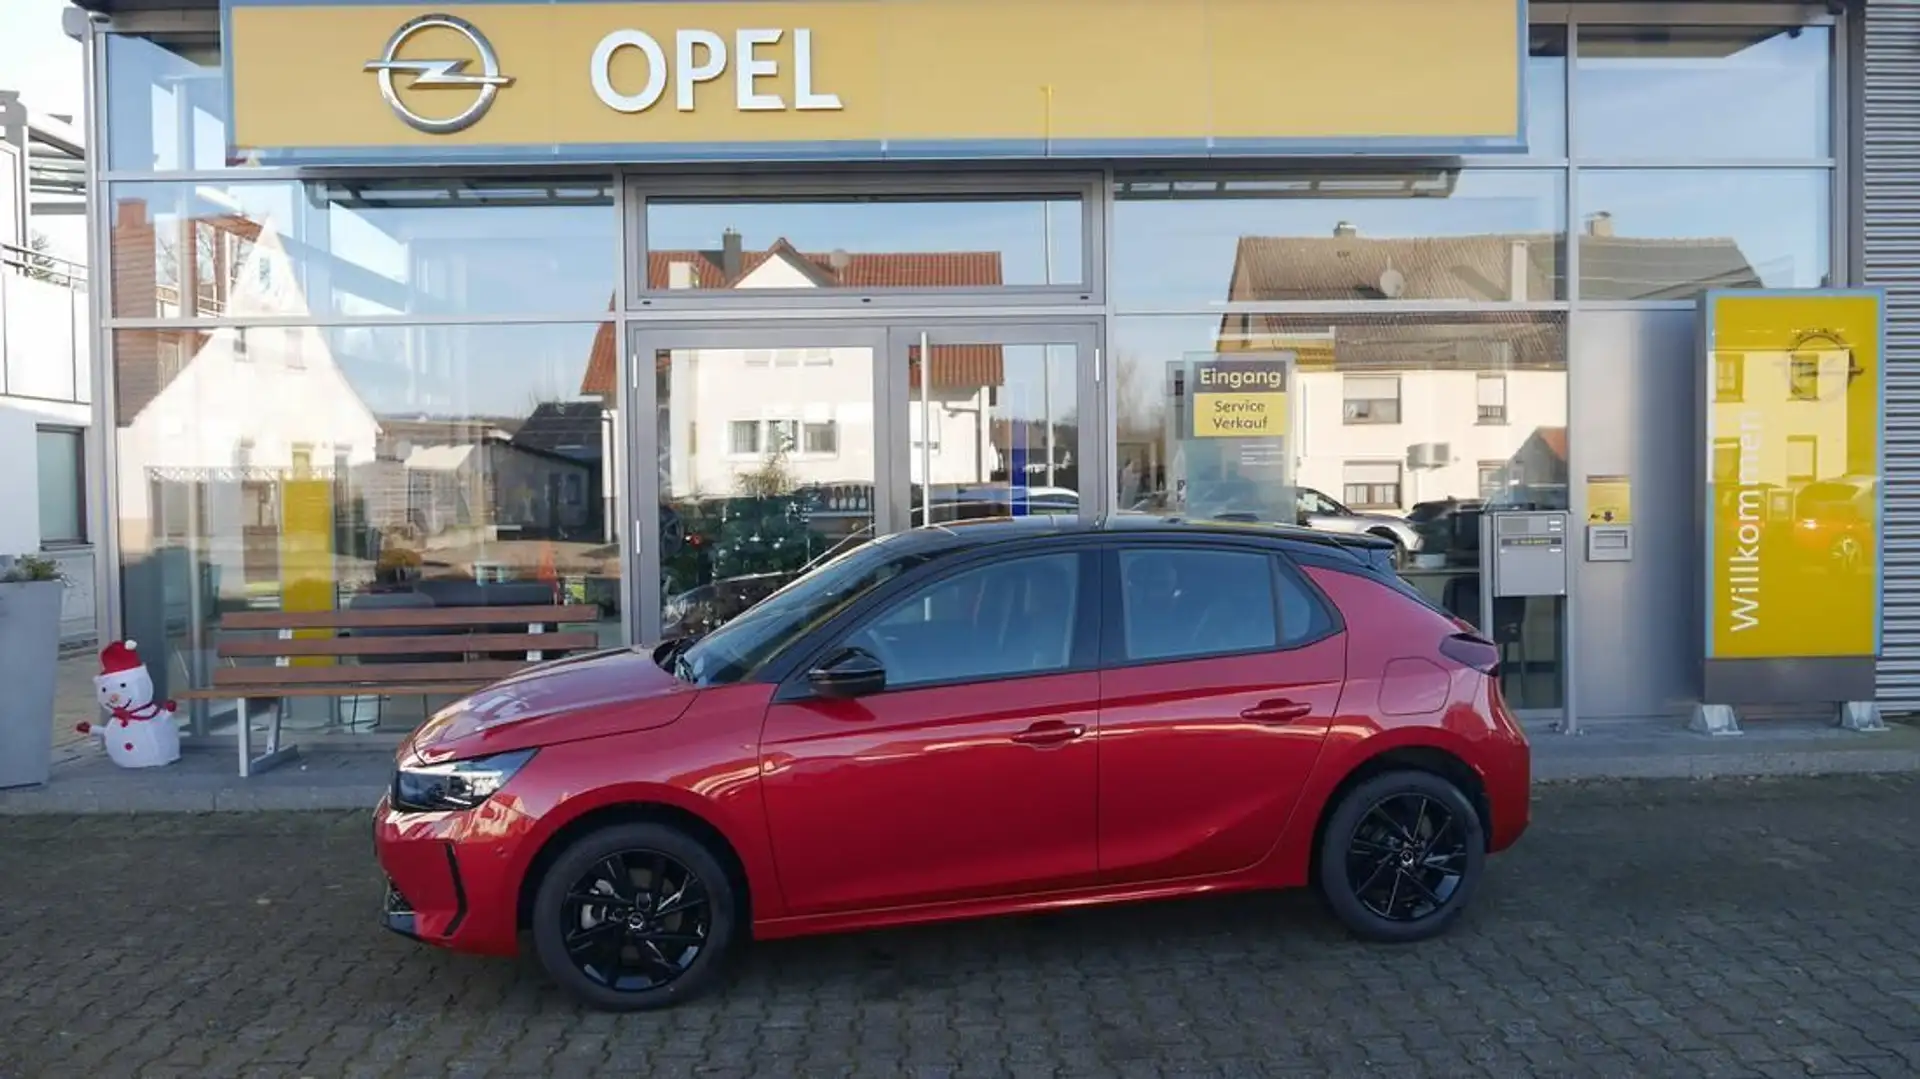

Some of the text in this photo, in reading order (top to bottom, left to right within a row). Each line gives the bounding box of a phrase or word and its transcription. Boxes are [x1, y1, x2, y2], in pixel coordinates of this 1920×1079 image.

[590, 28, 844, 112] OPEL
[1200, 367, 1281, 388] Eingang
[1214, 400, 1266, 413] Service
[1213, 416, 1268, 430] Verkauf
[1729, 411, 1761, 633] Willkommen
